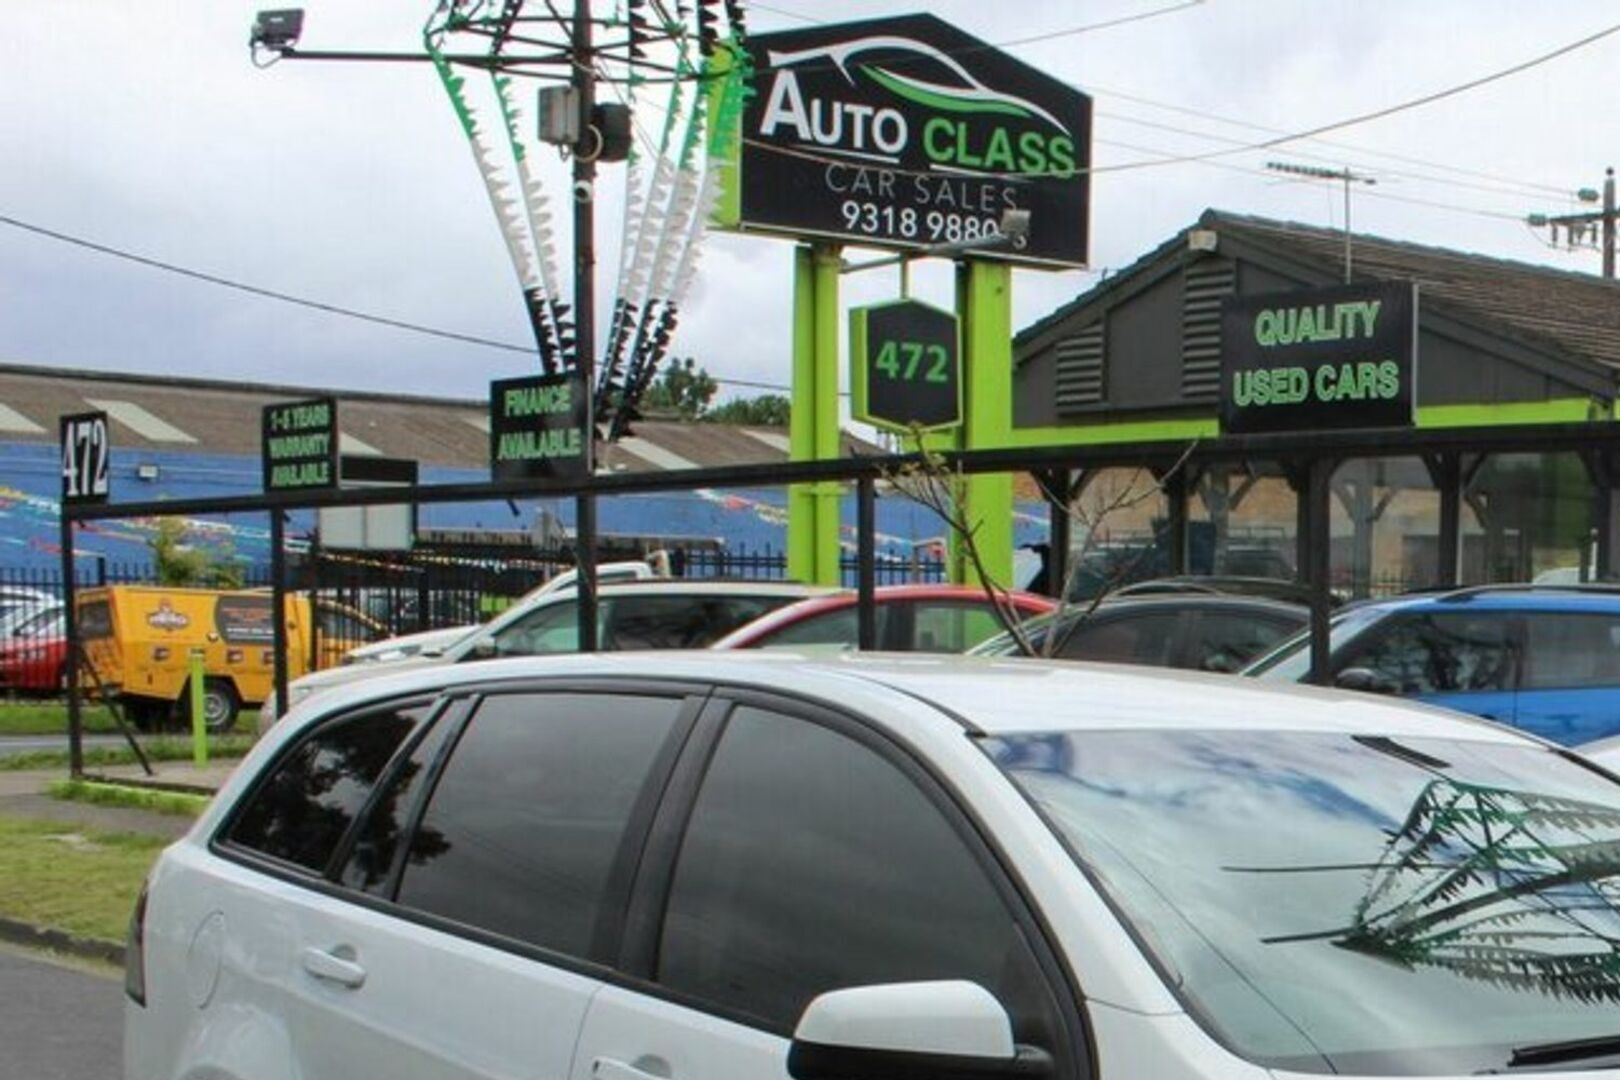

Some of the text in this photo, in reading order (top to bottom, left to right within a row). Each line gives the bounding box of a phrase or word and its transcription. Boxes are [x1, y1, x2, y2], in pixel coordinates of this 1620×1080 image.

[923, 117, 1076, 179] CLASS
[825, 162, 1018, 212] CAR SALES
[841, 200, 918, 237] 9318
[1255, 301, 1381, 345] QUALITY
[876, 341, 949, 382] 472
[1233, 360, 1399, 407] USED CARS
[504, 383, 571, 417] FINANCE
[62, 419, 108, 496] 472
[497, 427, 581, 460] AVAILABLE
